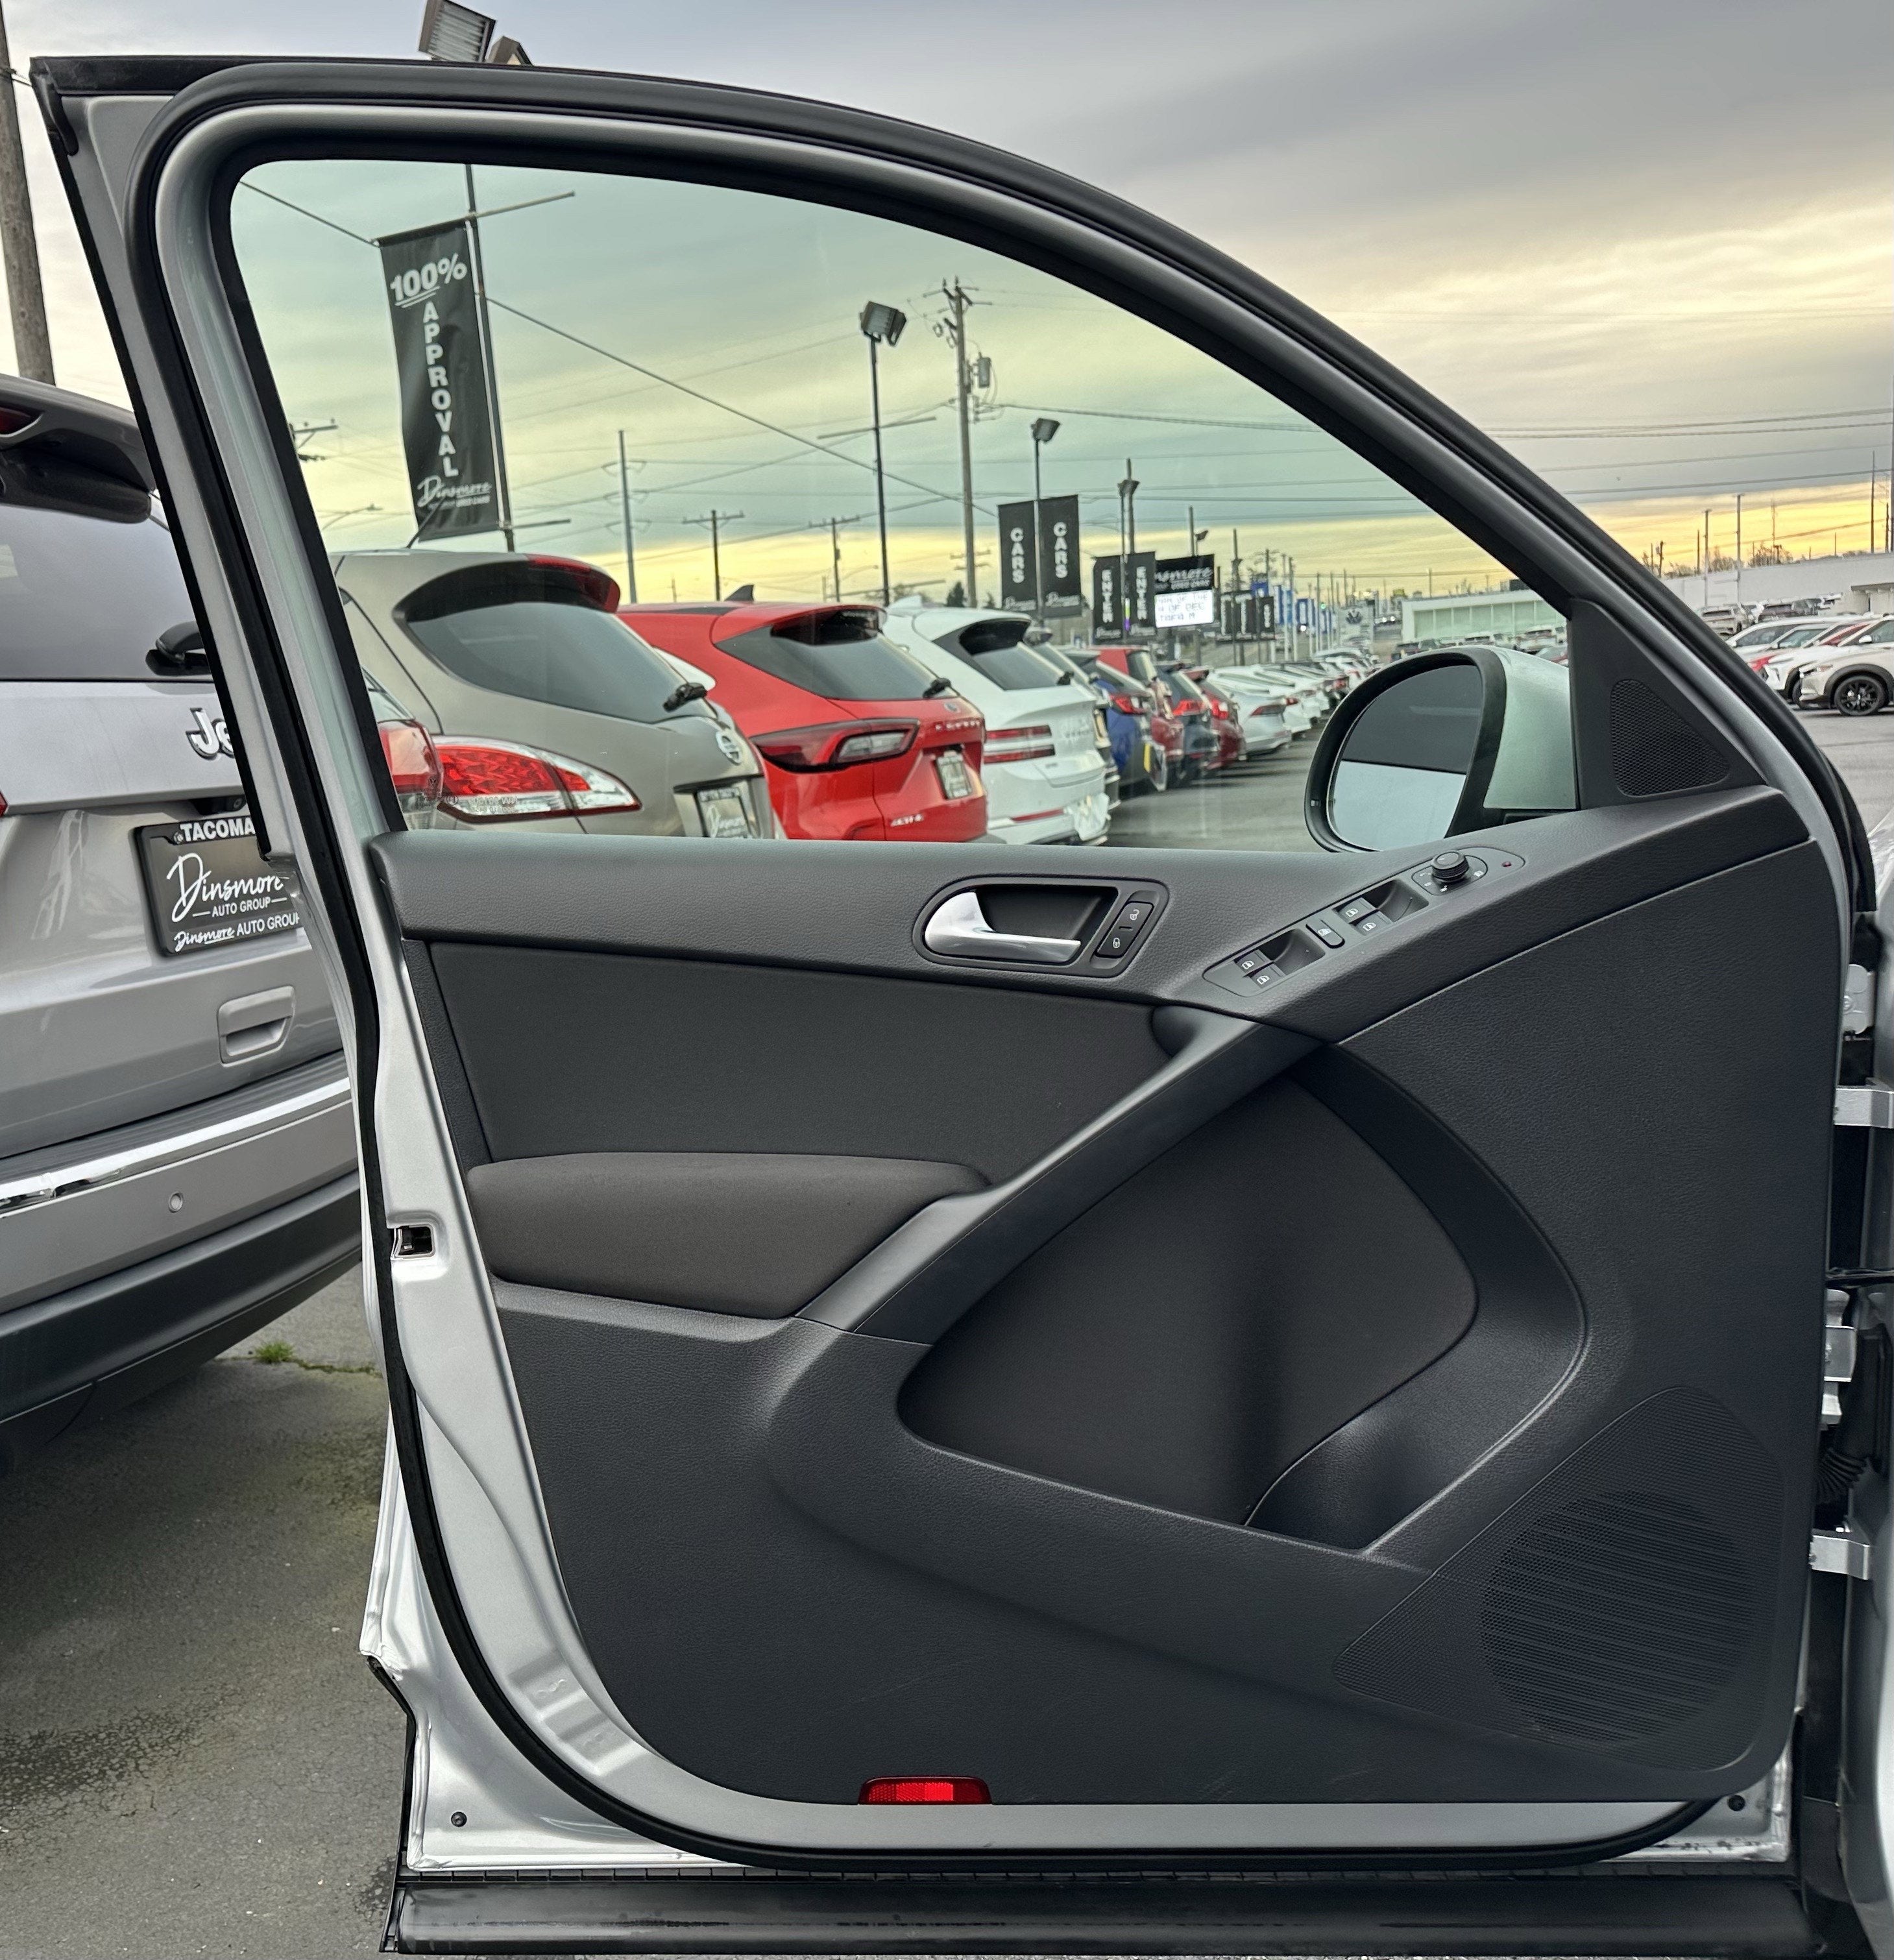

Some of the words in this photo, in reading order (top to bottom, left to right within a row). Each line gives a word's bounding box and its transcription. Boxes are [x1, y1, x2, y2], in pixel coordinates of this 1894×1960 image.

[390, 253, 467, 299] 100%
[422, 301, 459, 477] APPROVAL
[1010, 527, 1025, 583] CARS
[1054, 522, 1068, 578] CARS
[186, 708, 234, 758] Je
[180, 818, 256, 841] TACOMA
[166, 853, 284, 922] Dinsmore
[212, 902, 237, 917] AUTO
[239, 896, 271, 912] GROUP
[173, 926, 235, 952] Dinsmore
[236, 919, 265, 936] AUTO
